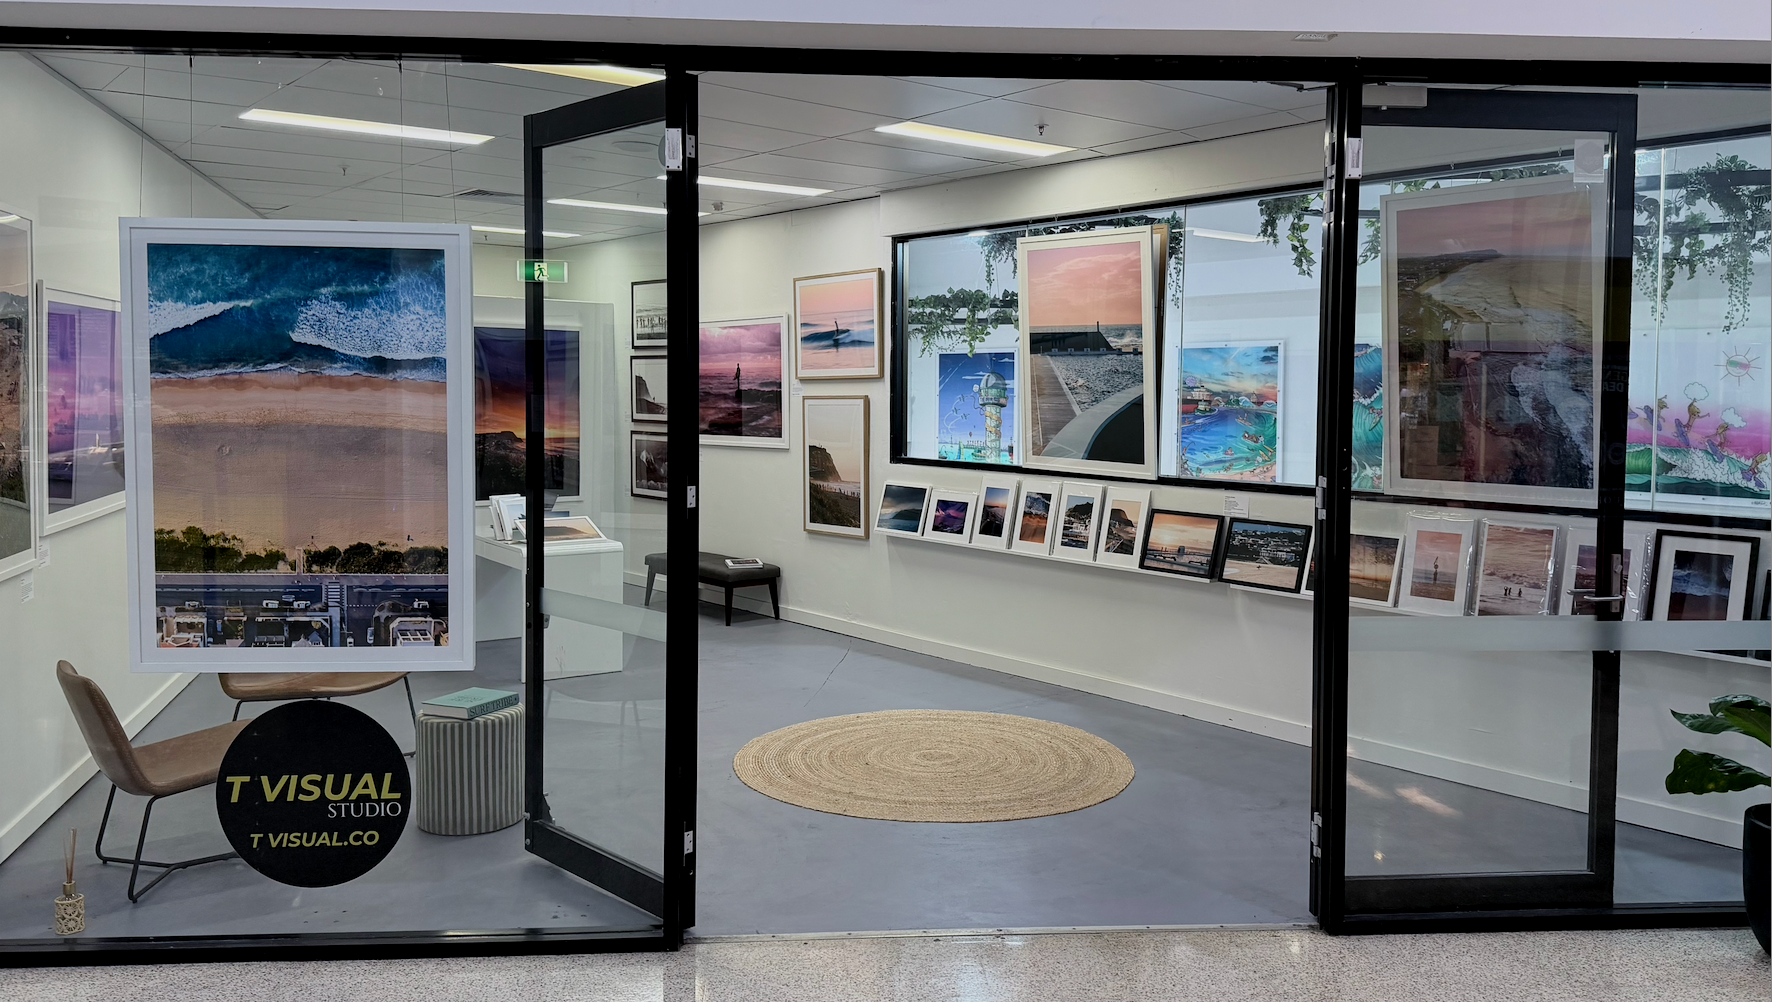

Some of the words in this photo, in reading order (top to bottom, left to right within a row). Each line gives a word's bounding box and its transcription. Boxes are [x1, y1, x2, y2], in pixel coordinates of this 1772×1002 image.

[469, 704, 490, 716] SURF
[491, 697, 513, 709] TRIBE
[226, 776, 251, 803] T
[260, 773, 402, 802] VISUAL
[327, 802, 402, 818] STUDIO
[250, 833, 263, 848] T
[268, 830, 379, 848] VISUAL.CO
